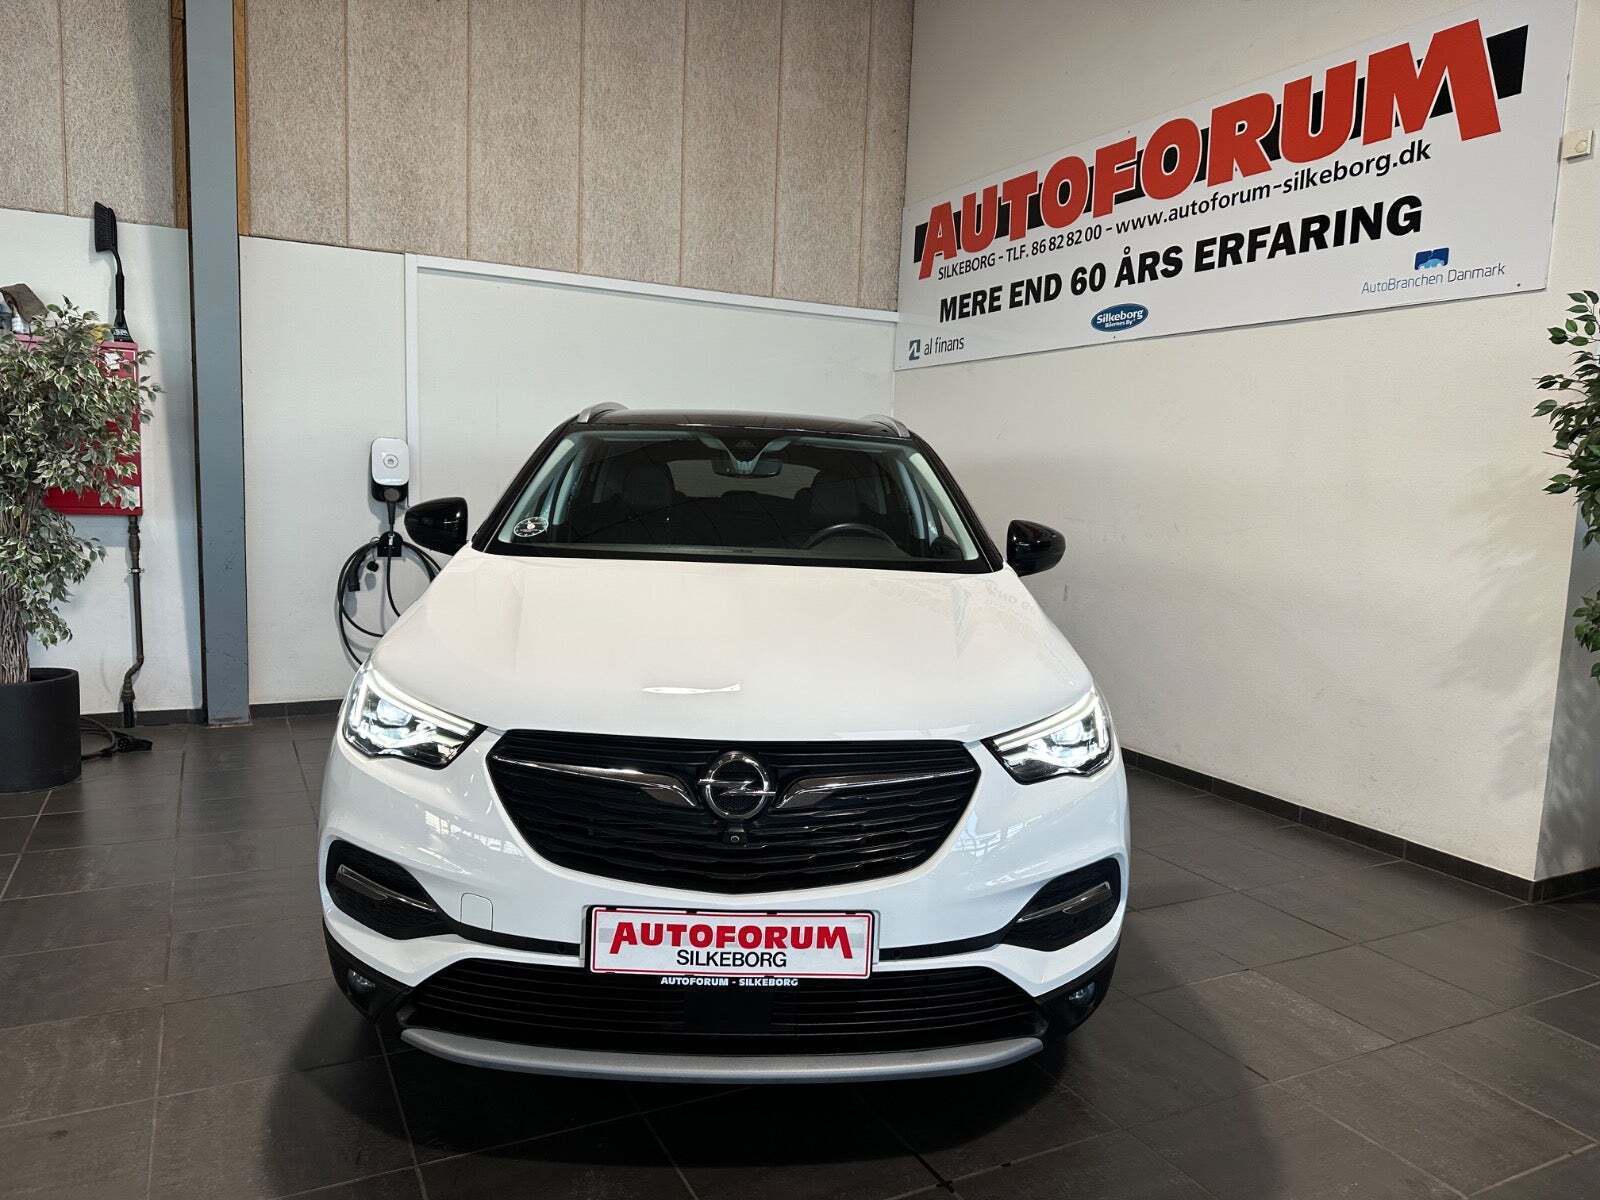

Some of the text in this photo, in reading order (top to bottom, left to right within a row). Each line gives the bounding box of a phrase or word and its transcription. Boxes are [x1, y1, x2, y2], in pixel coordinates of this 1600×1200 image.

[918, 19, 1501, 280] AUTOFORUM
[937, 253, 996, 281] SILKEBORG
[1006, 244, 1029, 263] TLF.
[1115, 139, 1432, 235] www.autoforum-silkeborg.dk
[939, 195, 1422, 323] MERE END 60 ÅRS ERFARING
[1361, 262, 1506, 295] AutoBranchen Danmark
[1096, 309, 1144, 324] Silkeborg
[924, 336, 965, 356] al finans
[609, 921, 853, 959] AUTOFORUM
[676, 949, 787, 968] SILKEBORG
[660, 976, 729, 987] AUTOFORUM
[738, 978, 799, 987] SILKEBORG
